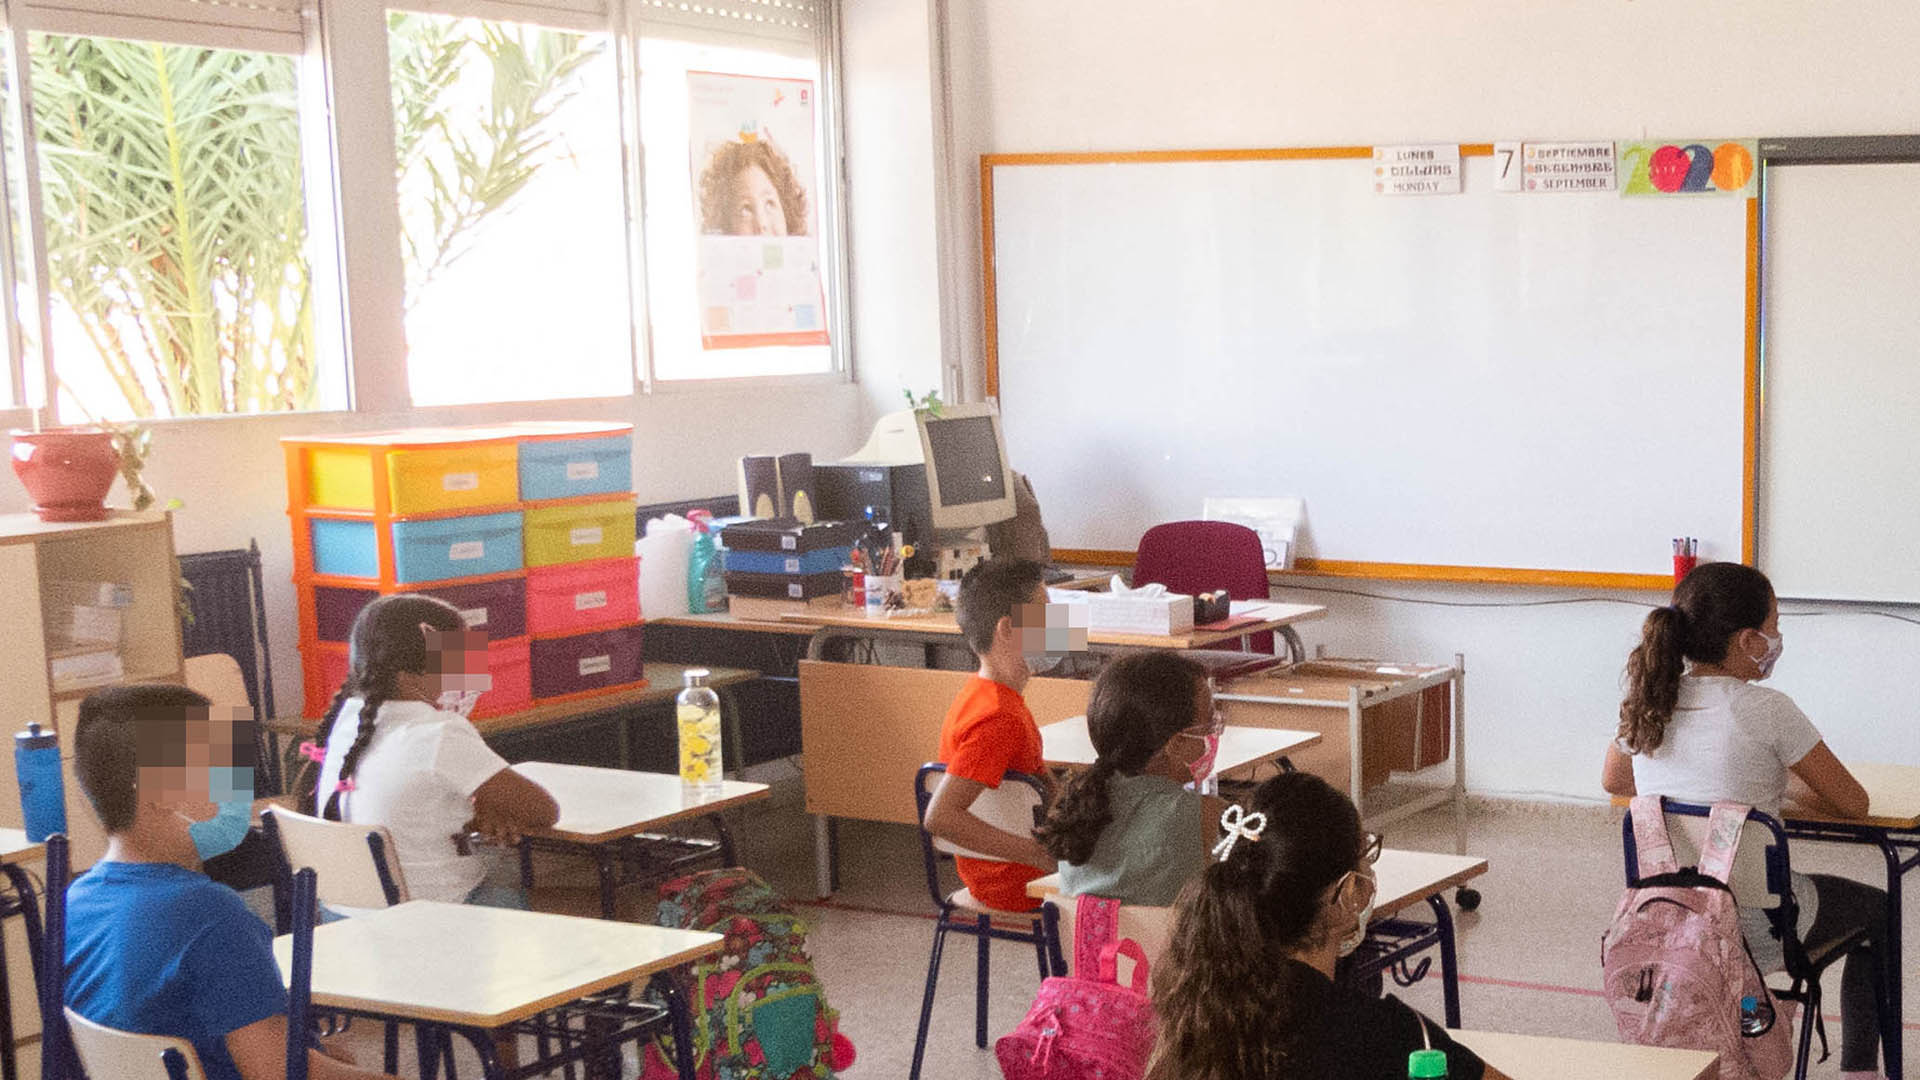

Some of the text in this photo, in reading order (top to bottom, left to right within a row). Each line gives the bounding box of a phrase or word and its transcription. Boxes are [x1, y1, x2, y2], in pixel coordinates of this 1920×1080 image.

[1397, 150, 1435, 161] LUNES
[1538, 147, 1611, 158] SEPTIEMBRE
[1497, 149, 1514, 178] 7
[1623, 141, 1754, 195] 2020
[1393, 181, 1440, 192] MONDAY
[1543, 178, 1607, 189] SEPTEMBER
